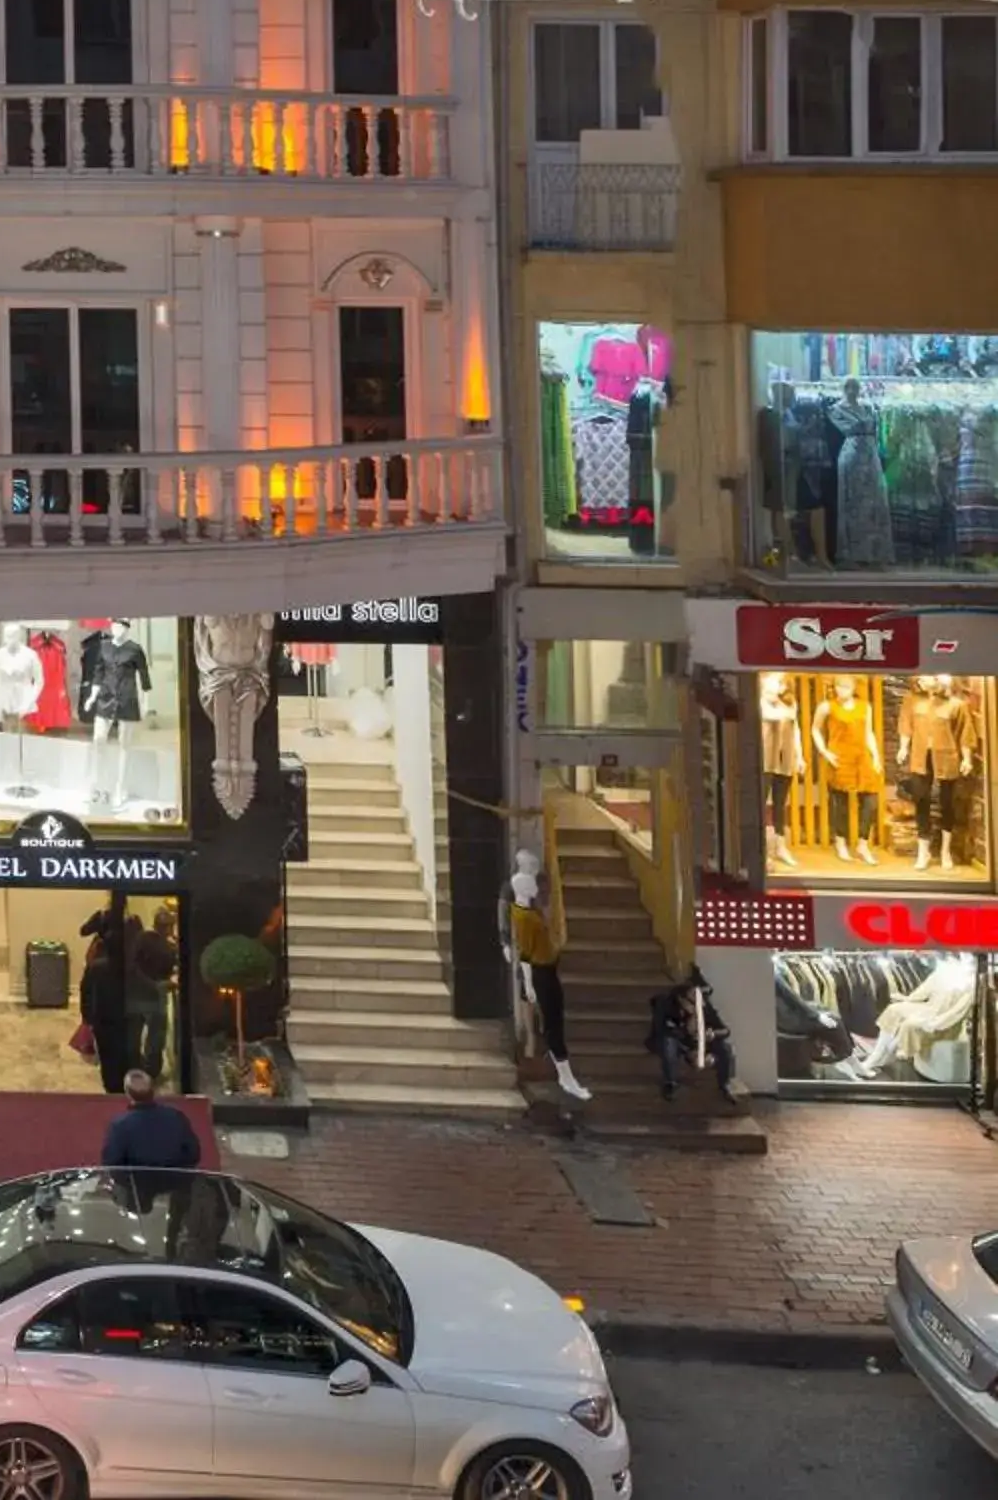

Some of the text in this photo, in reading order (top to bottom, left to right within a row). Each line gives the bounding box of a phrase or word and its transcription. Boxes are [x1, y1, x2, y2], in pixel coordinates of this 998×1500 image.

[351, 597, 440, 623] stella
[784, 617, 894, 661] Ser
[20, 839, 85, 848] BOUTIQUE
[40, 857, 176, 881] DARKMEN
